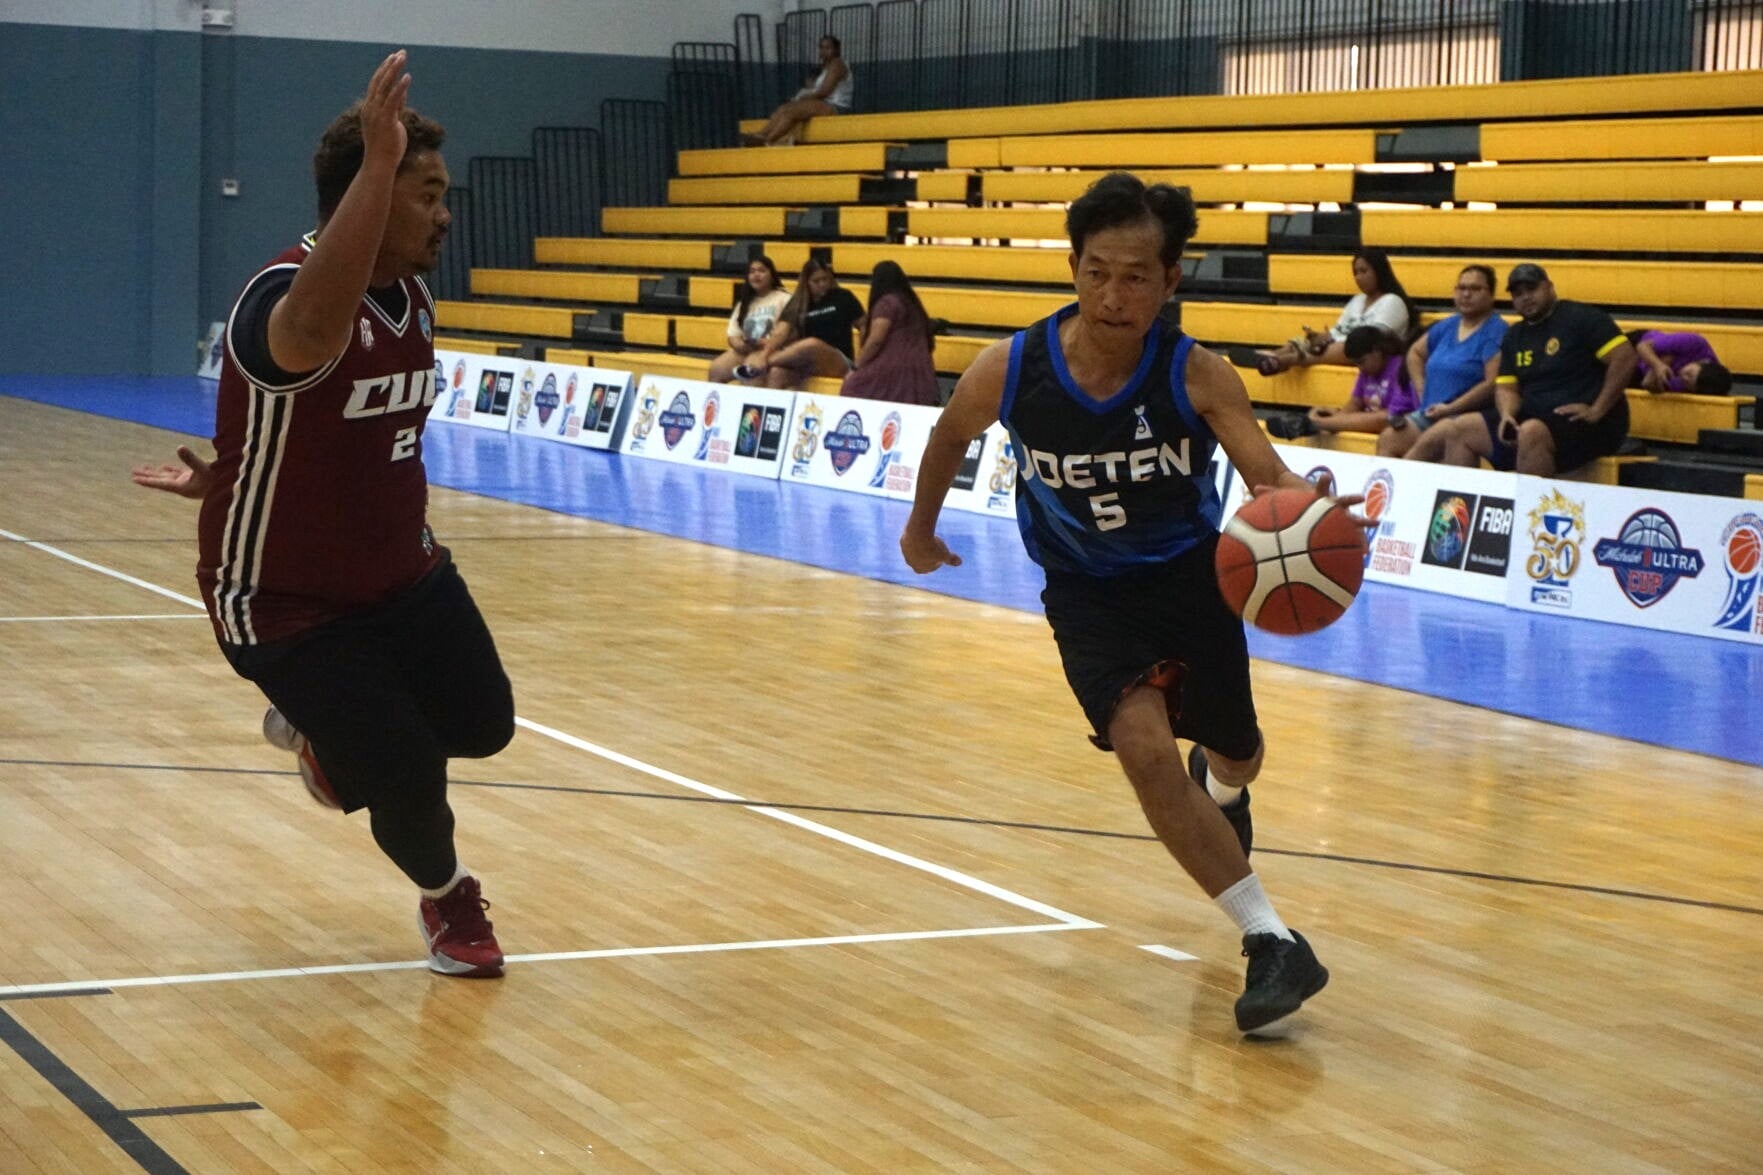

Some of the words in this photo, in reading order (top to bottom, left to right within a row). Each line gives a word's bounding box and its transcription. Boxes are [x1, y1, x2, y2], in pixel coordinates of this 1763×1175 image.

[1516, 350, 1533, 367] 15
[390, 426, 417, 462] 2
[1089, 492, 1127, 532] 5
[1479, 506, 1513, 535] FIBA
[1526, 533, 1580, 580] 50
[1652, 551, 1698, 572] ULTRA
[1627, 568, 1664, 596] CUP
